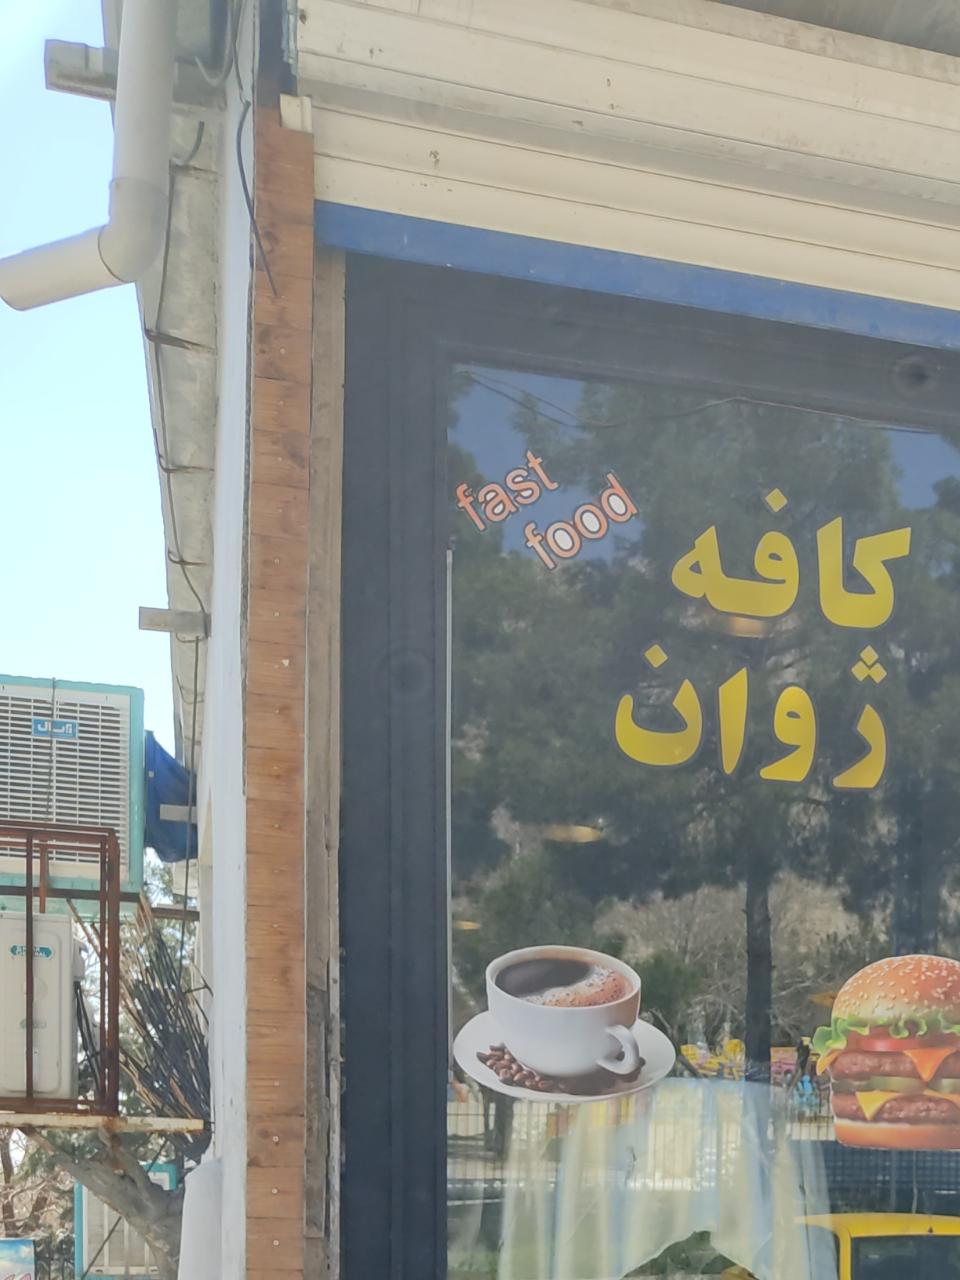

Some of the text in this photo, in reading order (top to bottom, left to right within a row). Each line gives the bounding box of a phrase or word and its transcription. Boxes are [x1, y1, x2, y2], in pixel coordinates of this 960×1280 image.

[456, 450, 559, 532] fast
[524, 471, 638, 569] food
[671, 487, 911, 629] کافه
[615, 644, 888, 789] ژوان
